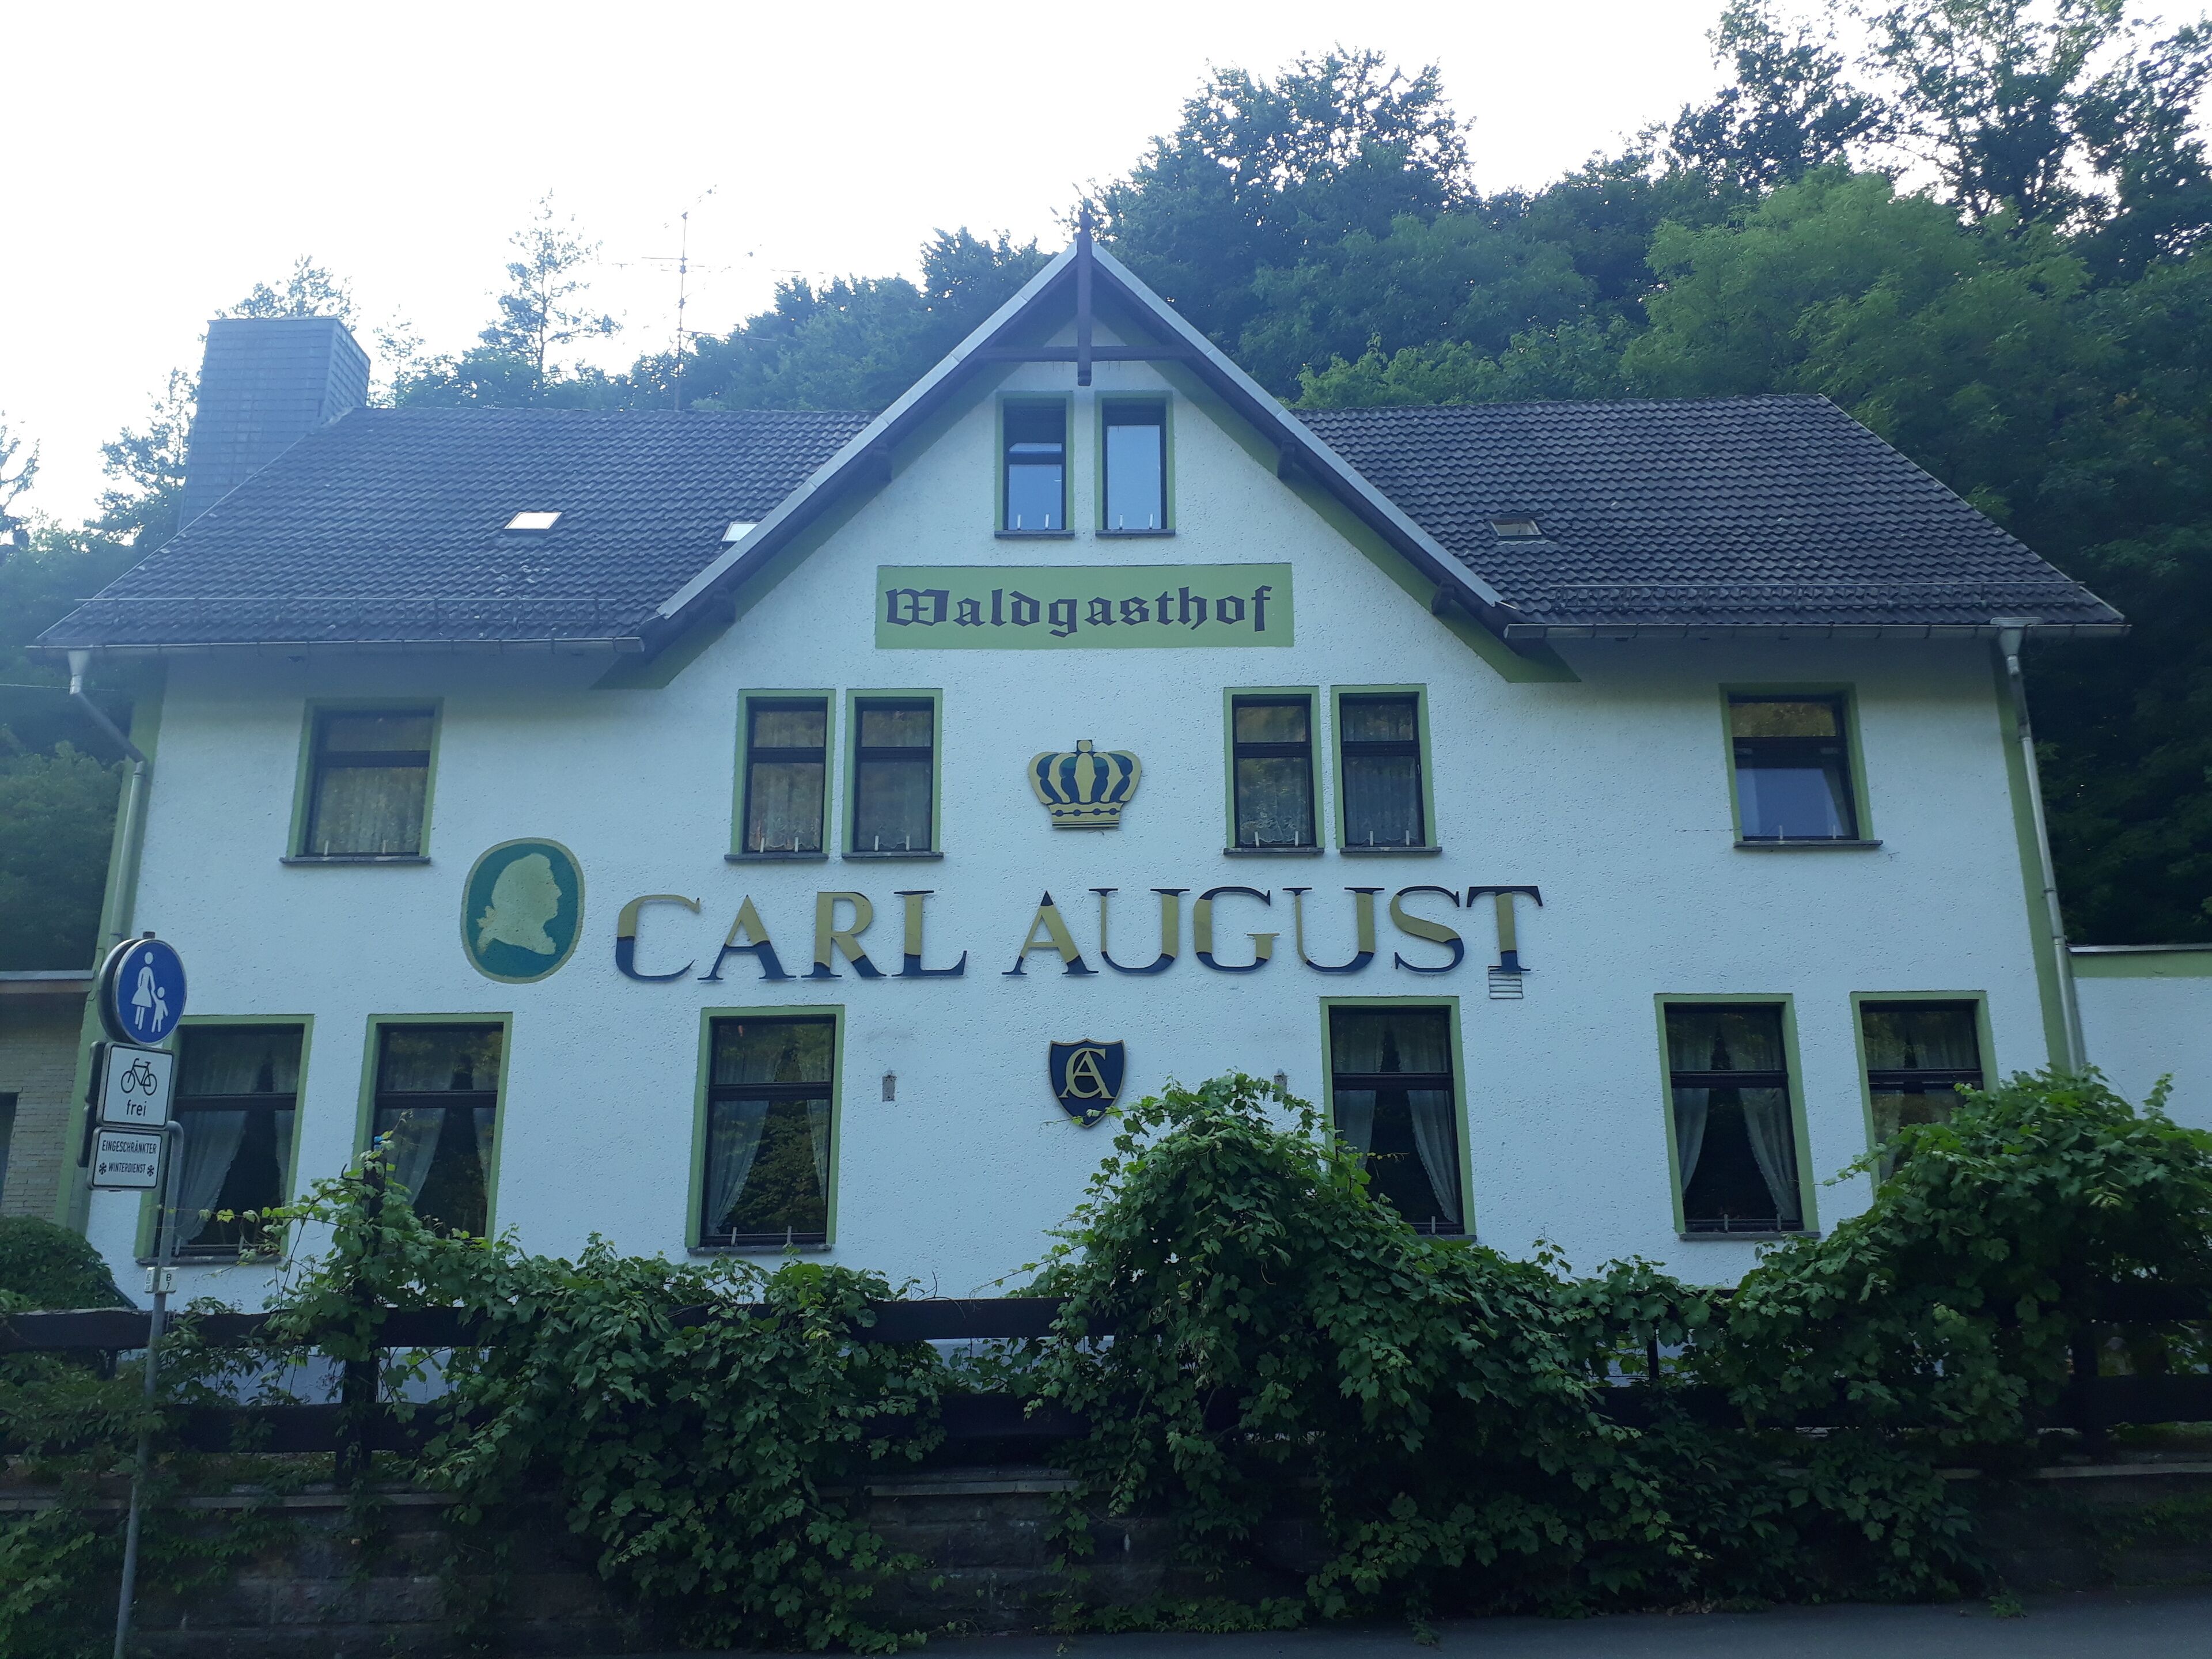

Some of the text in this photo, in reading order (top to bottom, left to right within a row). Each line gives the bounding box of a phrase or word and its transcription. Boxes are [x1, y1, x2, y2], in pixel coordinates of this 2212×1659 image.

[885, 585, 1272, 638] Waldgasthof
[615, 886, 1543, 980] CARL AUGUST
[126, 1099, 147, 1116] frei
[102, 1140, 157, 1154] EINGESCHRÄNKTER
[108, 1162, 146, 1173] WINTERDIENST
[166, 1273, 172, 1282] B
